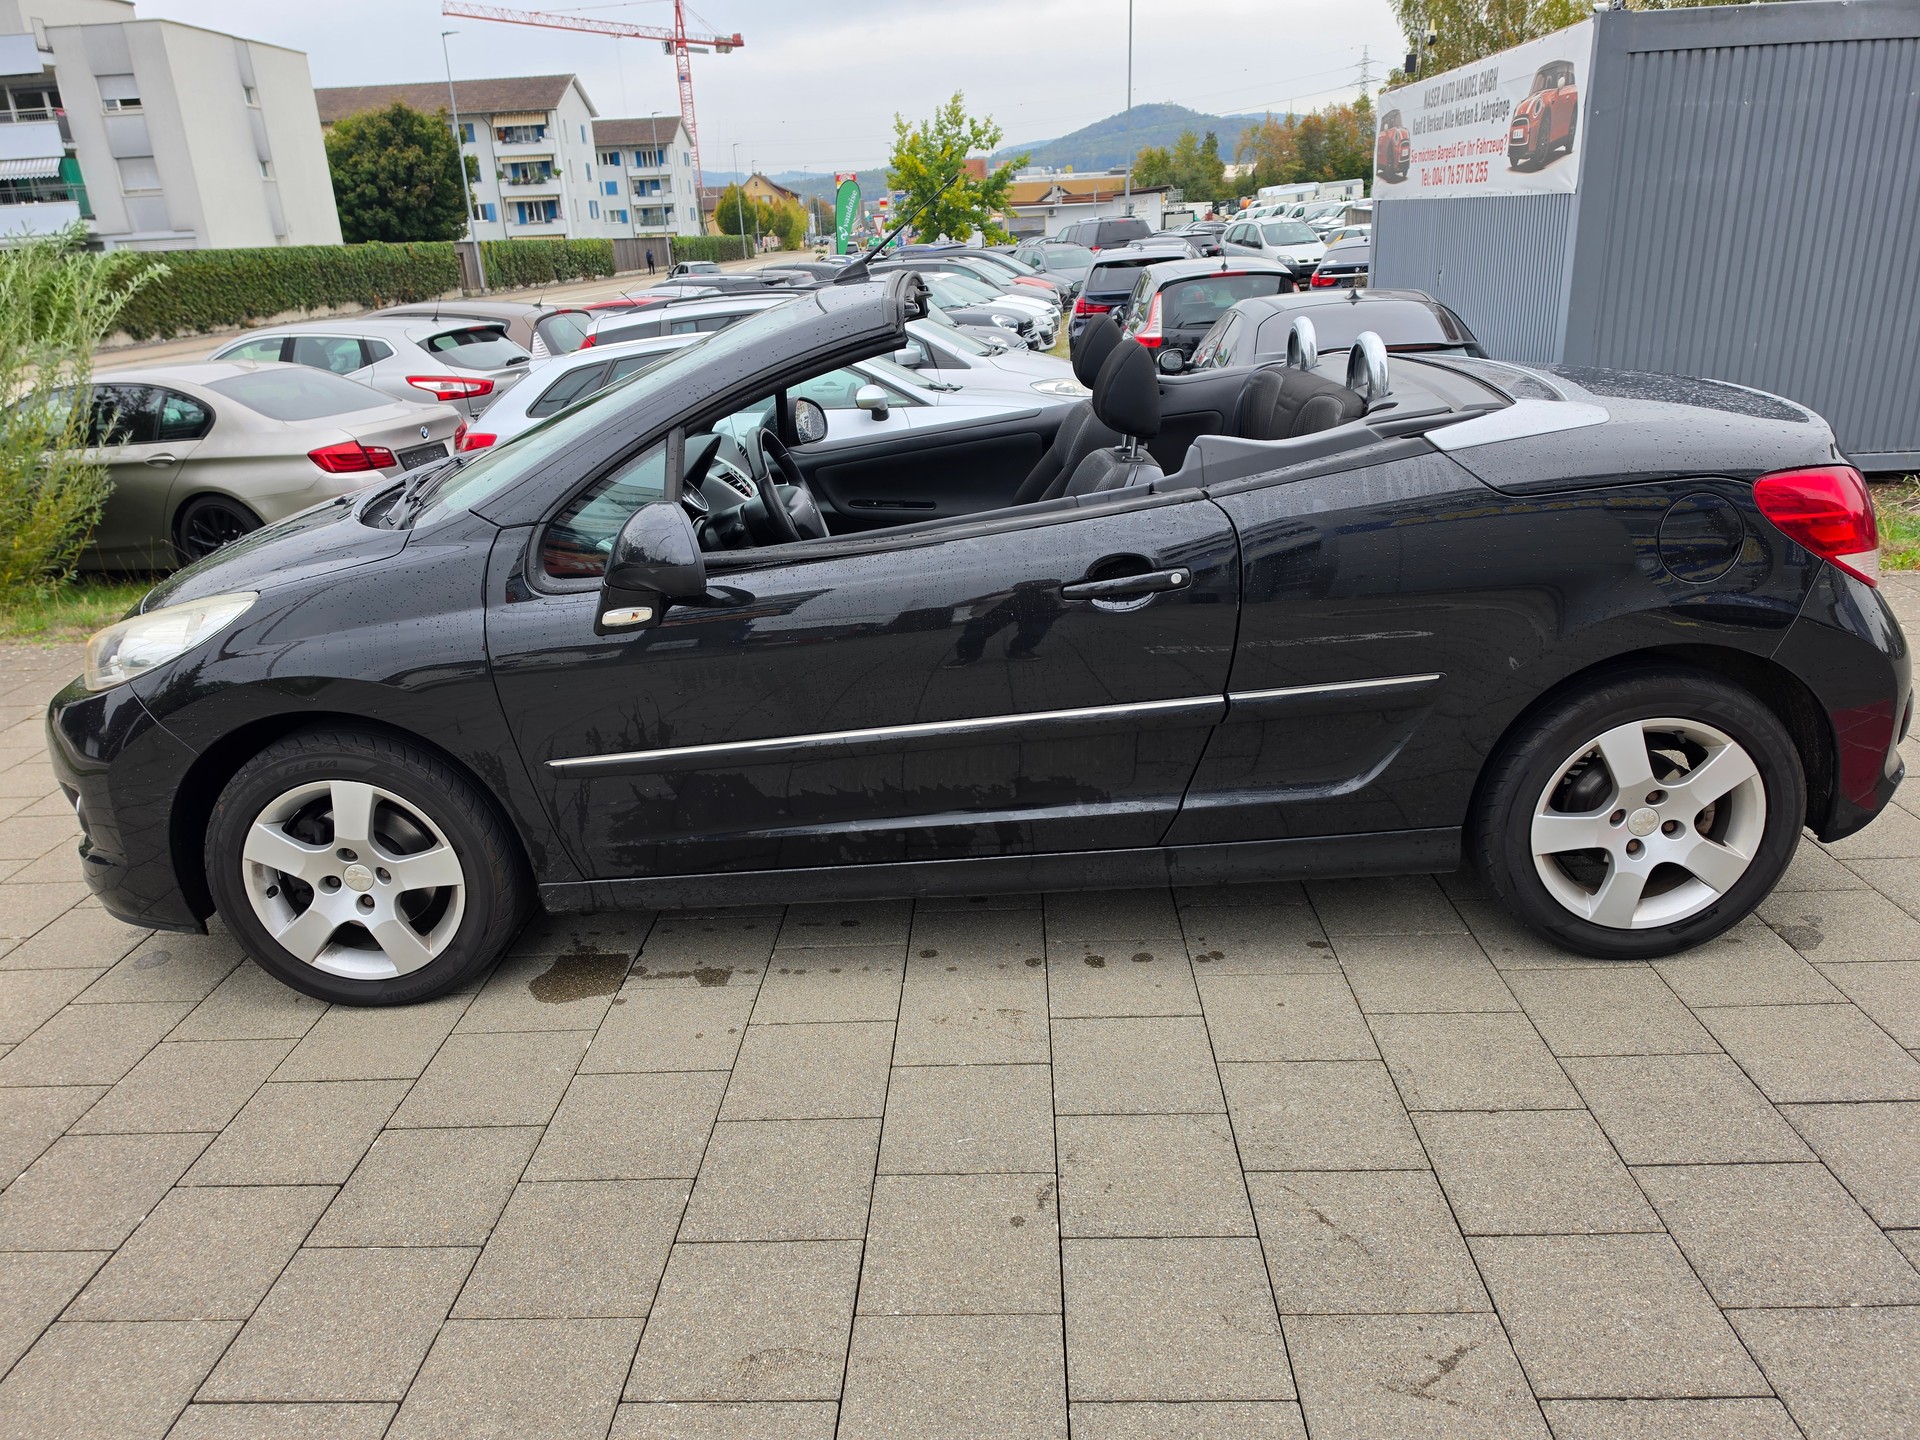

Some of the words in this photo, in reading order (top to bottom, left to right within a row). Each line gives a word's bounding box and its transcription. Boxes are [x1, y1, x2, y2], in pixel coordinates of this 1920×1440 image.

[1440, 81, 1455, 106] AUTO
[1455, 74, 1478, 102] HANDEL
[1479, 66, 1499, 95] GMBH
[1412, 118, 1422, 135] Kauf
[1427, 112, 1444, 132] Verkauf
[1444, 110, 1454, 129] Alle
[1454, 105, 1473, 127] Marken
[1479, 97, 1510, 124] Jahrgänge
[1418, 146, 1437, 162] möchten
[1437, 143, 1456, 162] Bargeld
[1457, 141, 1466, 157] Für
[1467, 139, 1476, 156] Ihr
[1476, 134, 1508, 156] Fahrzeug?
[1421, 168, 1431, 186] Tel:
[1432, 165, 1446, 185] 0041
[1447, 165, 1455, 184] 76
[1456, 163, 1465, 184] 57
[1465, 162, 1474, 183] 05
[1475, 160, 1489, 183] 255
[843, 189, 858, 227] vaudoise
[284, 759, 338, 776] FLEVA
[384, 968, 455, 1002] YOKOHAMA
